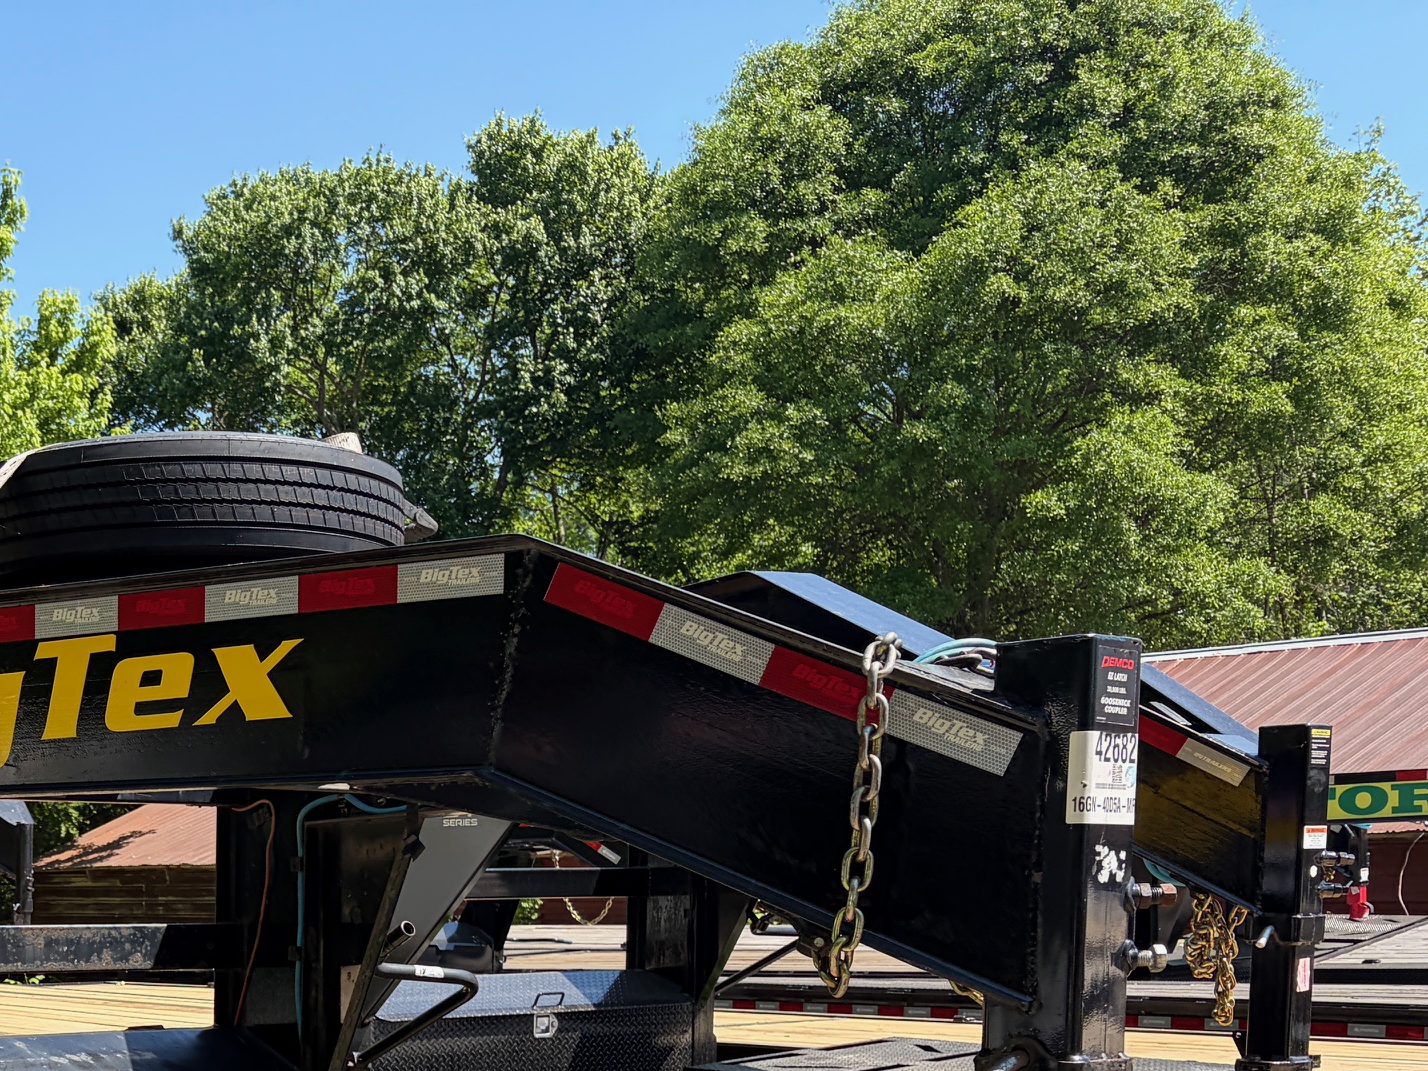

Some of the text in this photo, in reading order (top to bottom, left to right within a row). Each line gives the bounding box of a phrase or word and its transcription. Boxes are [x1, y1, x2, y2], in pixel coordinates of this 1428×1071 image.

[418, 566, 481, 584] BigTex
[225, 588, 278, 605] BigTex
[53, 607, 100, 622] BigTex
[680, 620, 747, 656] BigTex
[1101, 656, 1135, 670] DEMCO
[1100, 696, 1131, 707] GOOSENECK
[1104, 705, 1128, 715] COUPLER
[913, 707, 990, 745] BigTex
[943, 732, 984, 752] TRAILERS
[1095, 731, 1136, 763] 42682
[442, 818, 478, 827] SERIES
